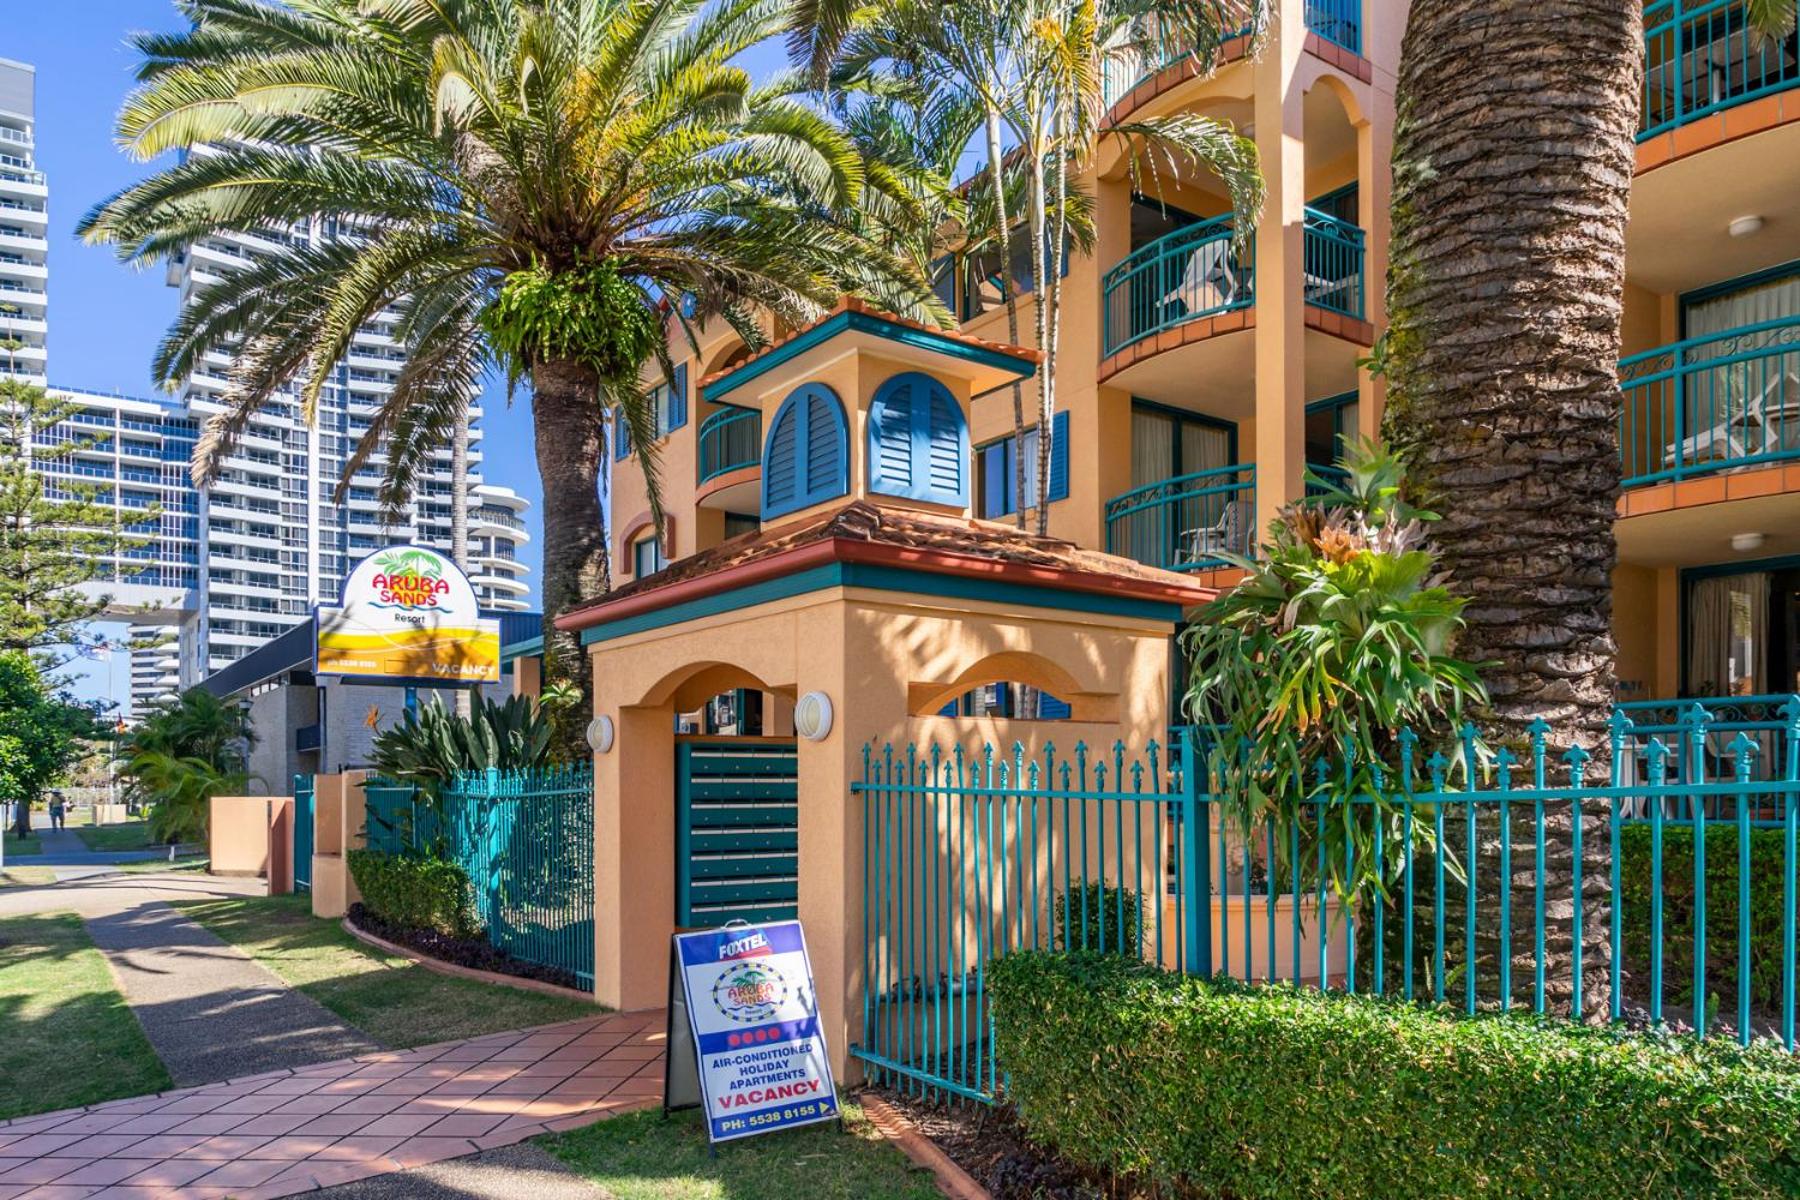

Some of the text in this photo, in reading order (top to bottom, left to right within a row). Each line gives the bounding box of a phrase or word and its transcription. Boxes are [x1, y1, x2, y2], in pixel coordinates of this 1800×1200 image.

[372, 574, 449, 594] ARUBA
[380, 591, 437, 606] SANDS
[395, 613, 425, 624] Resort
[432, 662, 496, 676] VACANCY
[719, 933, 767, 959] FOXTEL
[728, 982, 774, 999] ARUBA
[734, 993, 771, 1006] SANDS
[712, 1043, 813, 1069] AIR-CONDITIONED
[739, 1059, 790, 1076] HOLIDAY
[729, 1068, 806, 1090] APARTMENTS
[718, 1079, 820, 1109] VACANCY
[722, 1106, 816, 1132] PH: 5538 8155
